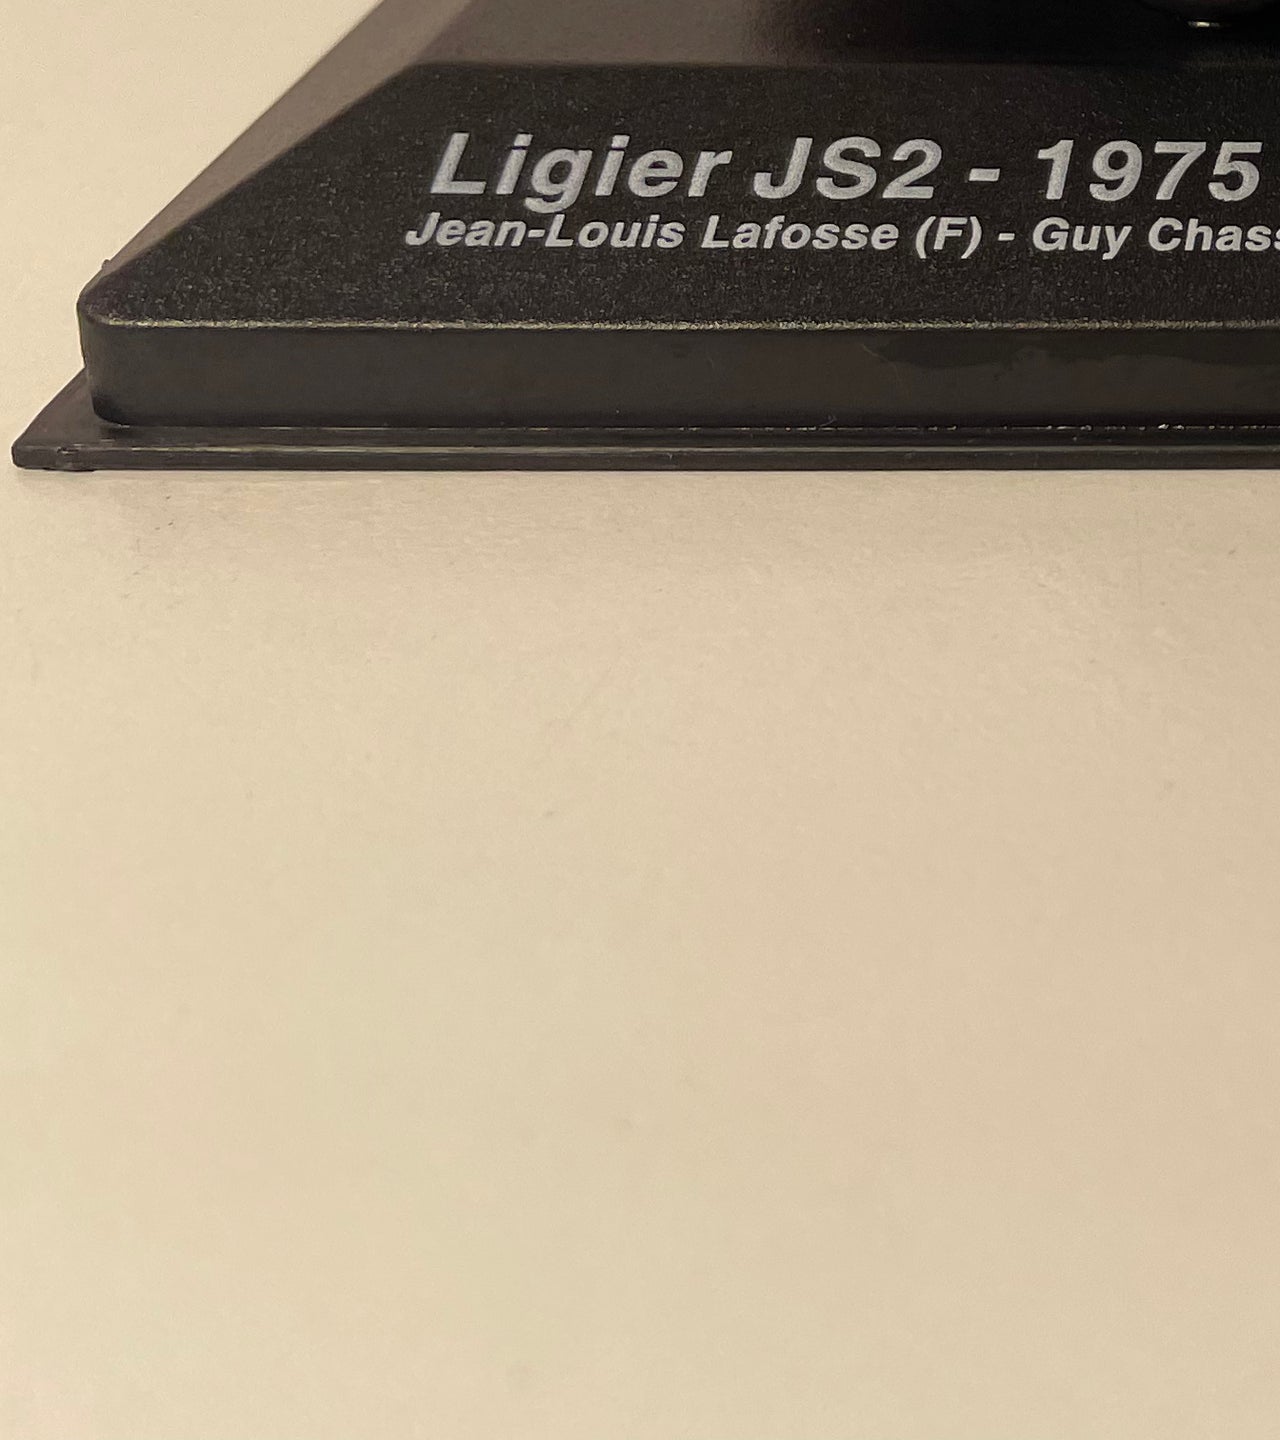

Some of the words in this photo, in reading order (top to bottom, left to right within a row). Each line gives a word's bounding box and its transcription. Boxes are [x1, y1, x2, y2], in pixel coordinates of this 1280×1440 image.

[431, 132, 733, 213] Ligier
[753, 136, 943, 200] JS2
[1037, 139, 1263, 202] 1975
[405, 212, 687, 248] Jean-Louis
[701, 215, 899, 250] Lafosse
[915, 216, 982, 259] (F)
[1032, 217, 1132, 260] Guy
